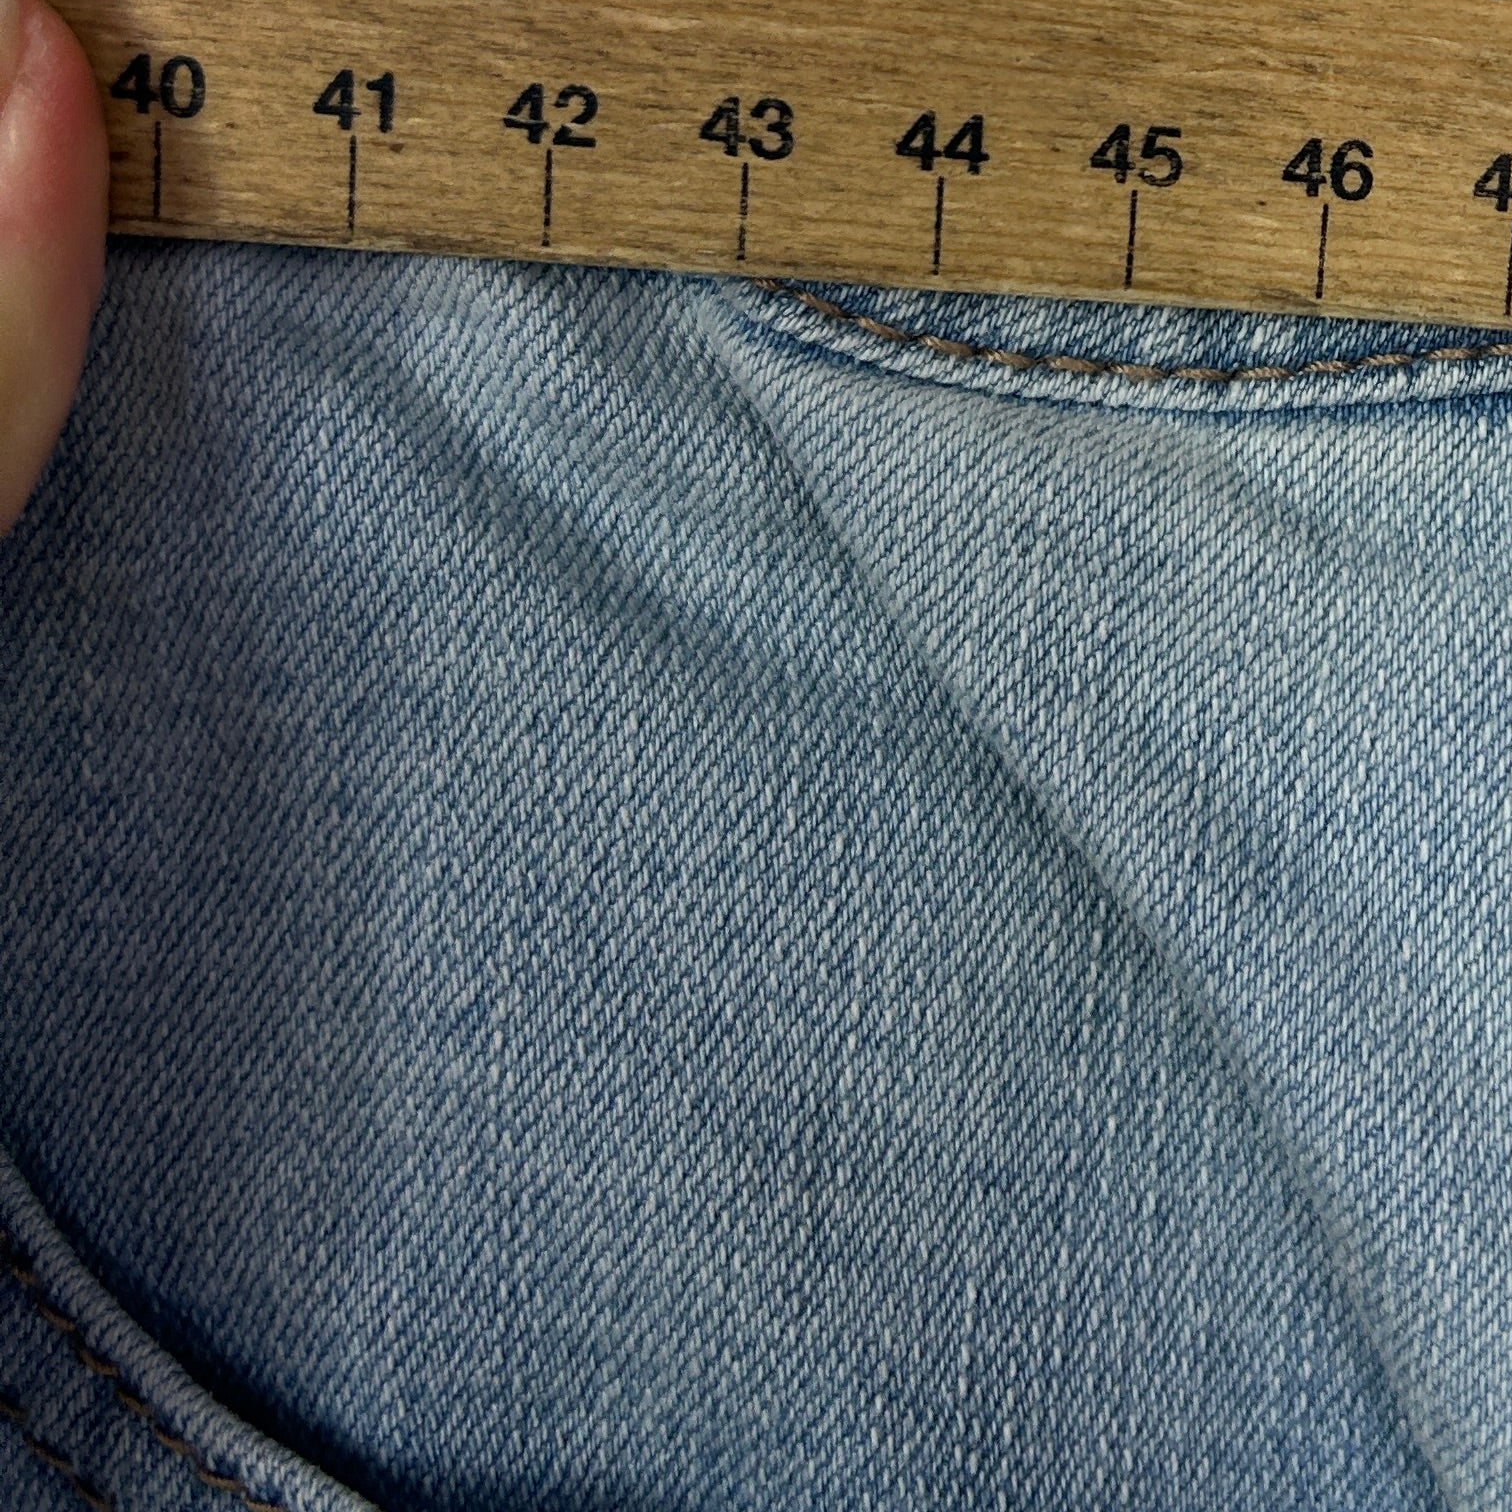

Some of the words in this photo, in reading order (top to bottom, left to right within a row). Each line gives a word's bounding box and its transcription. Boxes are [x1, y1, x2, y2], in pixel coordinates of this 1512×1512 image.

[109, 53, 207, 120] 40
[312, 69, 397, 134] 41
[502, 84, 600, 147] 42
[697, 95, 795, 160] 43
[894, 109, 991, 175] 44
[1088, 123, 1184, 188] 45
[1281, 138, 1373, 201] 46
